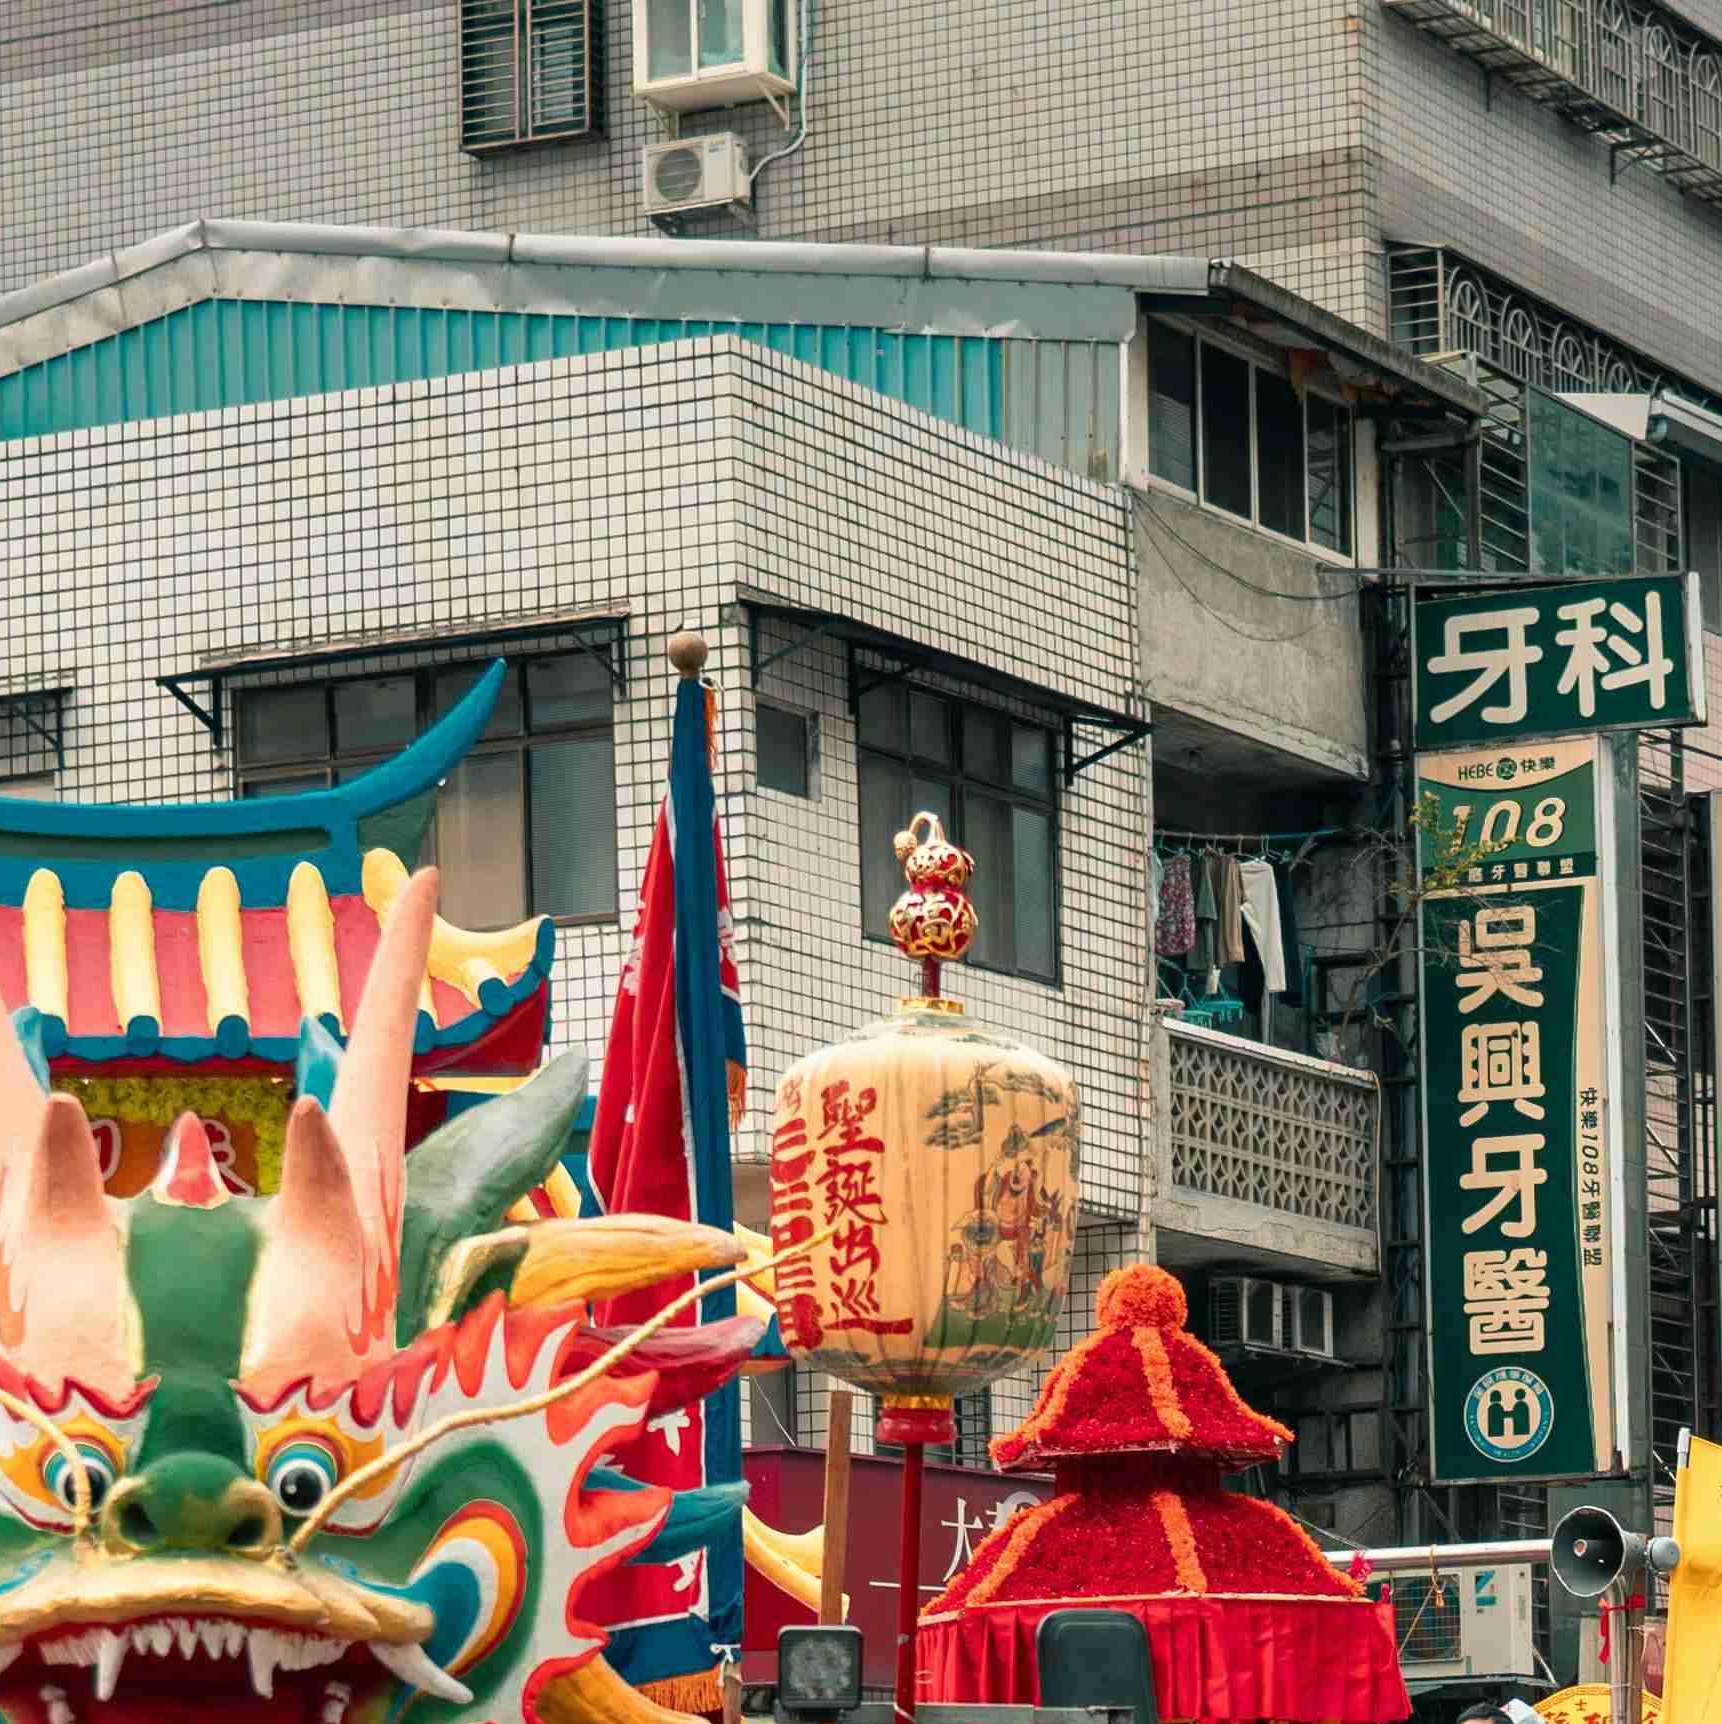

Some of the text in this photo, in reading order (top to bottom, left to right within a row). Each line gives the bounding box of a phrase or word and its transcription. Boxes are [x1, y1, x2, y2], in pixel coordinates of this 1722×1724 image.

[1427, 590, 1674, 724] 牙科
[1452, 797, 1566, 856] 108
[1458, 763, 1494, 780] HEBE
[1455, 905, 1552, 1355] 吳興牙醫
[815, 1079, 915, 1335] 聖誕出巡
